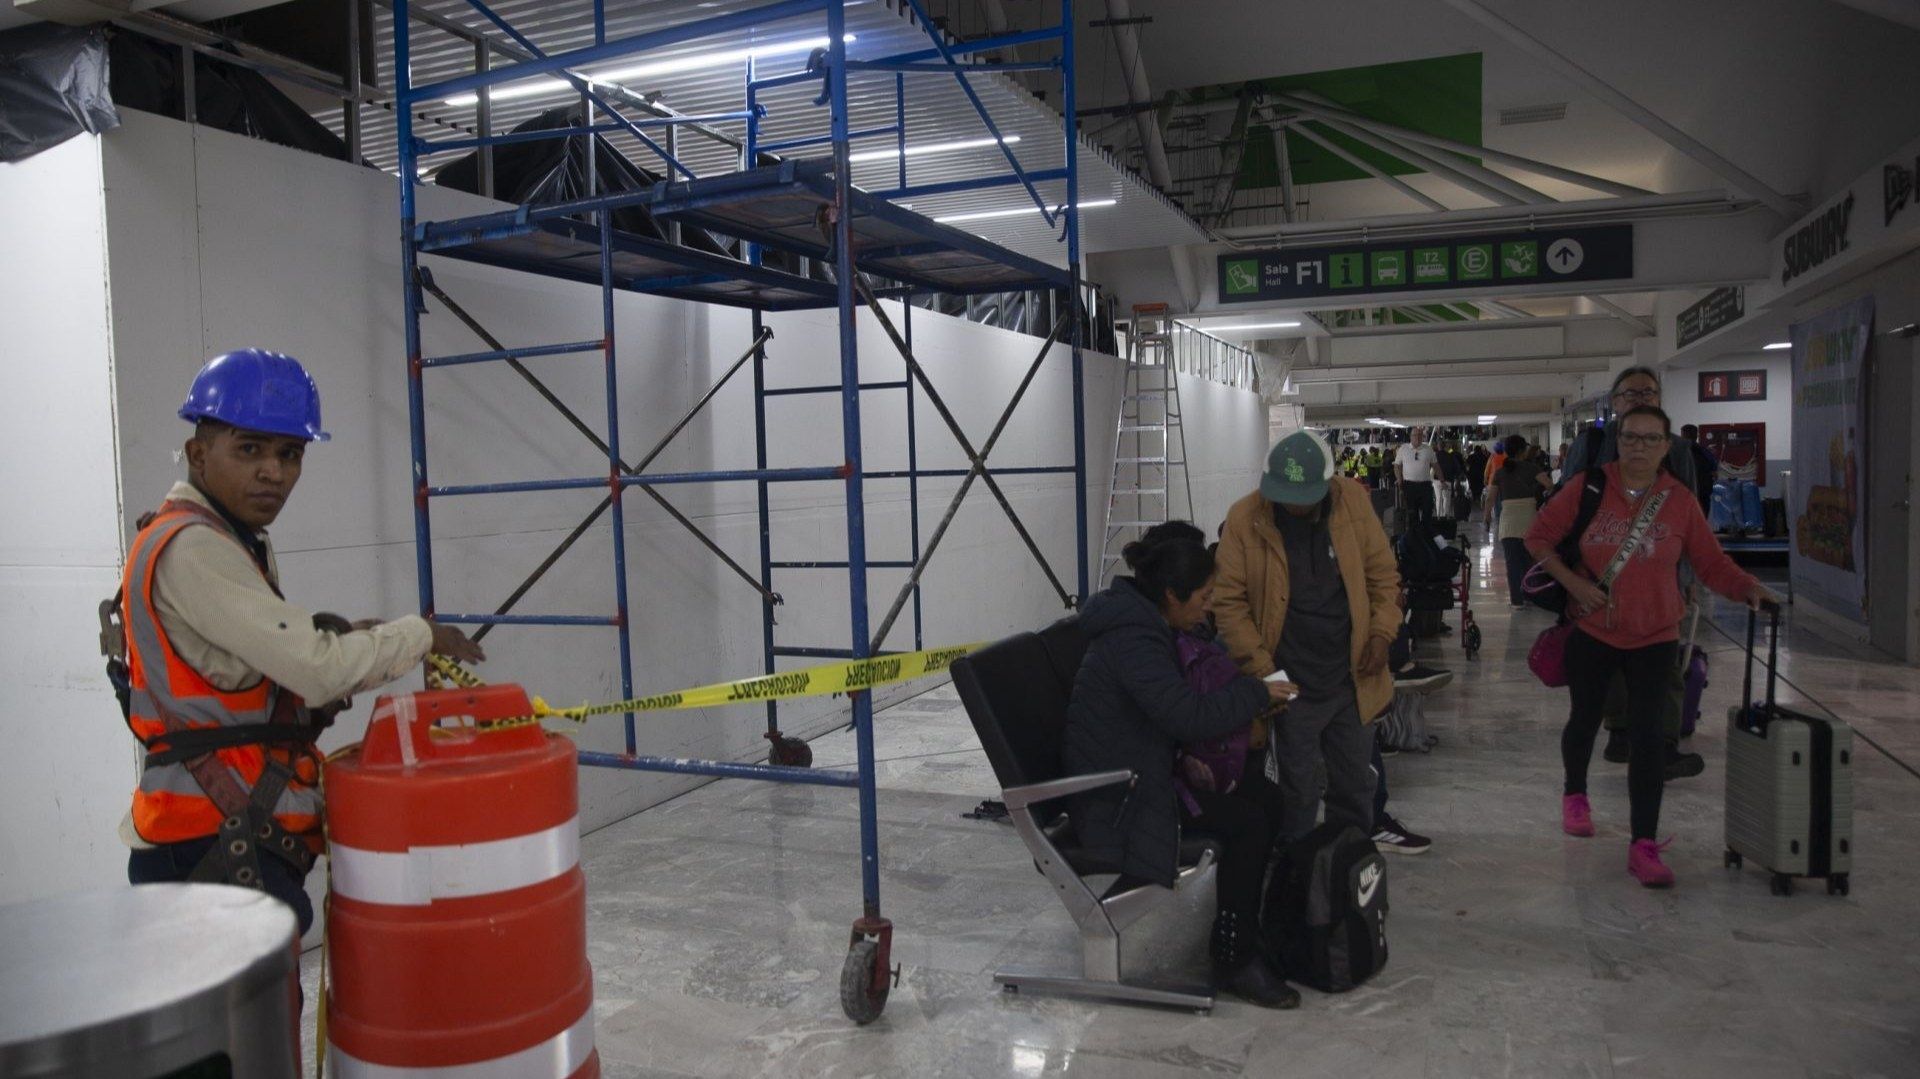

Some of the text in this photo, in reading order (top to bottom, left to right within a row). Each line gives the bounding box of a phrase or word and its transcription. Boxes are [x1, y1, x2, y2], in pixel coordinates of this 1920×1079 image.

[1783, 190, 1854, 287] SUBWAY
[1423, 252, 1439, 263] T2
[1265, 264, 1289, 275] Sala
[1296, 260, 1322, 285] F1
[1265, 277, 1281, 286] Hall
[1360, 862, 1377, 887] NIKE
